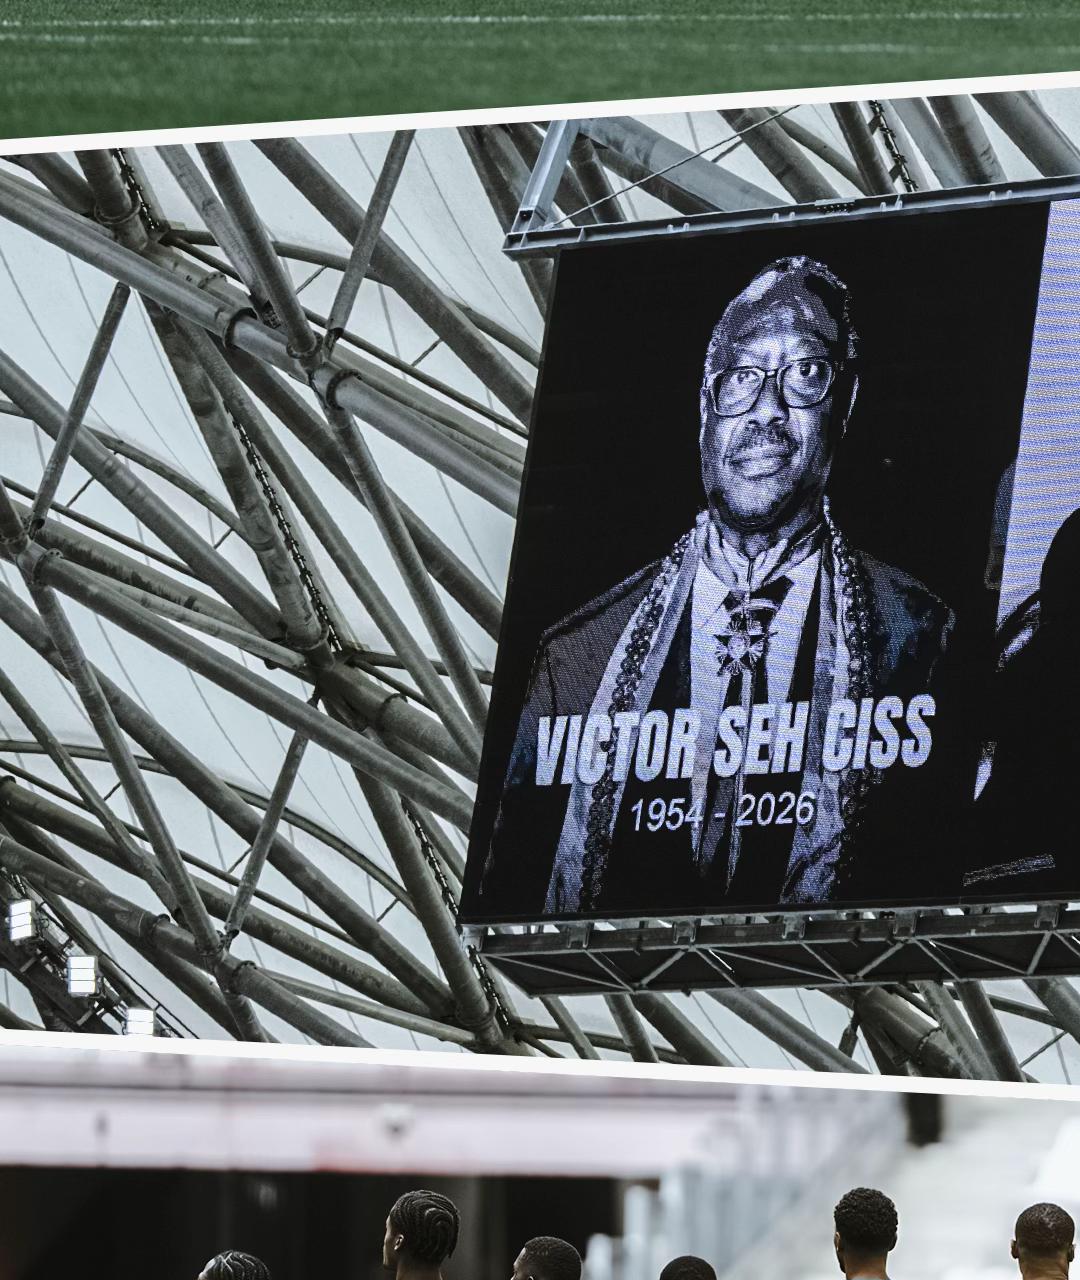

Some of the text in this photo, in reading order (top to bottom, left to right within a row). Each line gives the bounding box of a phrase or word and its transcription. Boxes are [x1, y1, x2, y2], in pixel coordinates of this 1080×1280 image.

[535, 694, 936, 786] VICTOR SEH CISS
[630, 797, 704, 832] 1954
[736, 791, 816, 827] 2026
